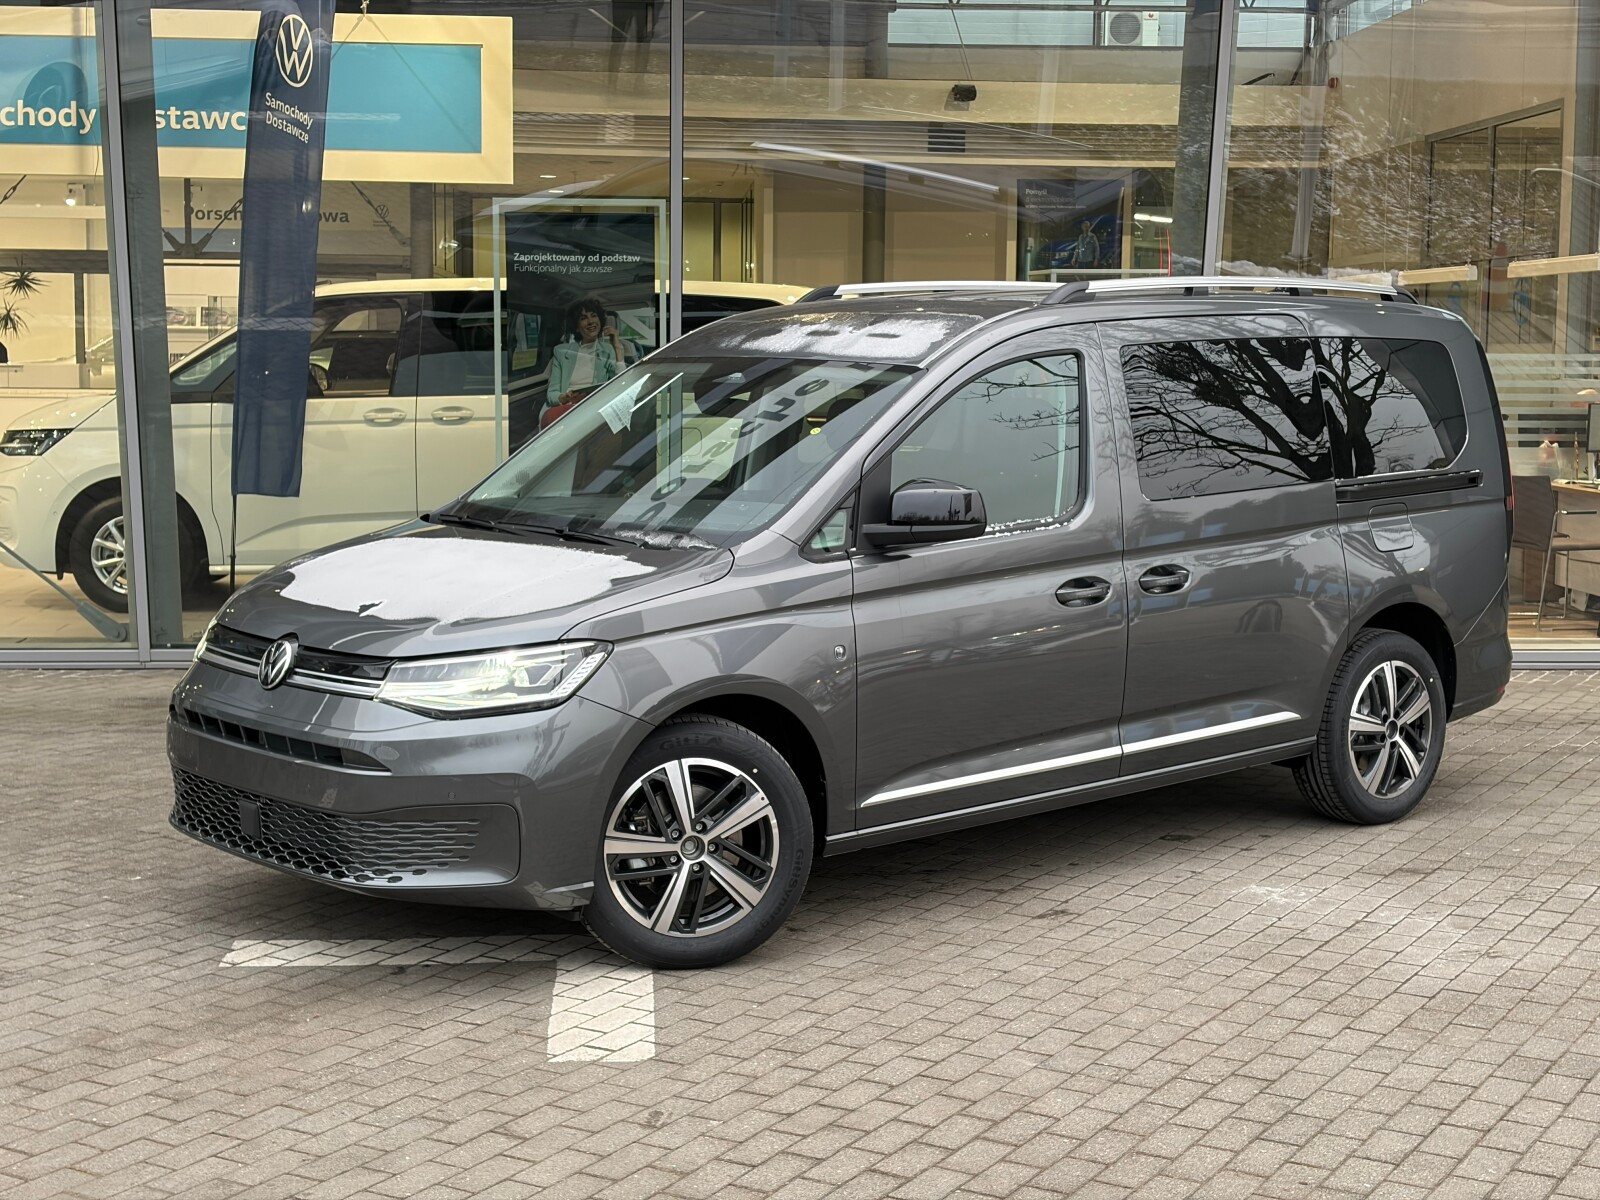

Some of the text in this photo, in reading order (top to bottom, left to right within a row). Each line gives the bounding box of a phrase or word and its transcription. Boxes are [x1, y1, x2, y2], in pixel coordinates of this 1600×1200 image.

[0, 99, 246, 134] chody stawc
[265, 92, 314, 130] Samochody
[265, 110, 309, 144] Dostawcze
[513, 252, 641, 263] Zaprojektowany od podstaw
[514, 263, 567, 274] Funkcjonalny
[568, 265, 581, 274] jak
